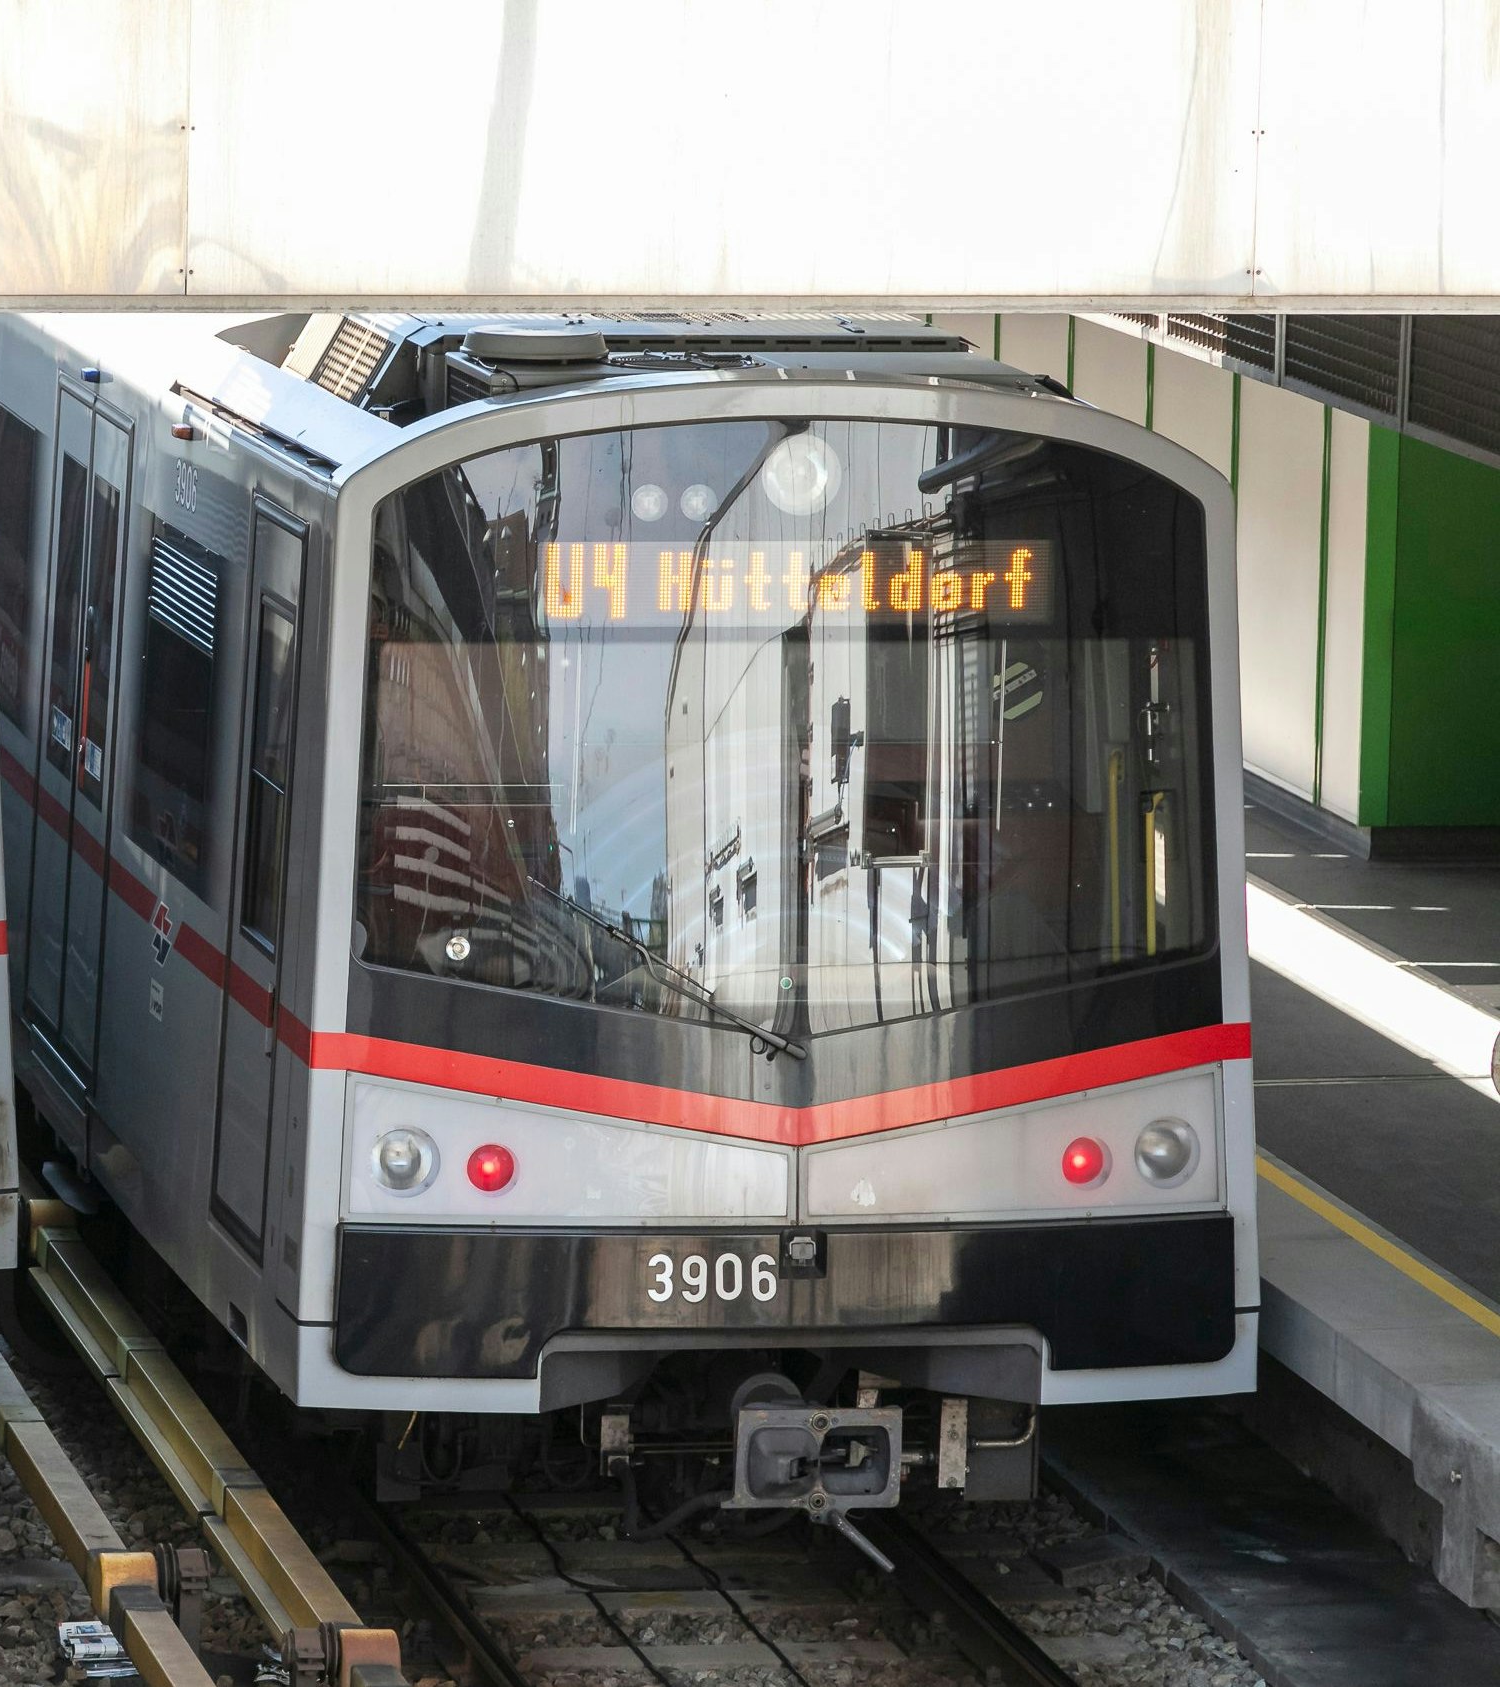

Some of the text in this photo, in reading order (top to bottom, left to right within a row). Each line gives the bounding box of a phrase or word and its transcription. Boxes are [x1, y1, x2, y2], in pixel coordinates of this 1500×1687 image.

[175, 457, 198, 513] 3906
[546, 542, 1033, 619] U4 Hütteldorf
[647, 1252, 777, 1303] 3906
